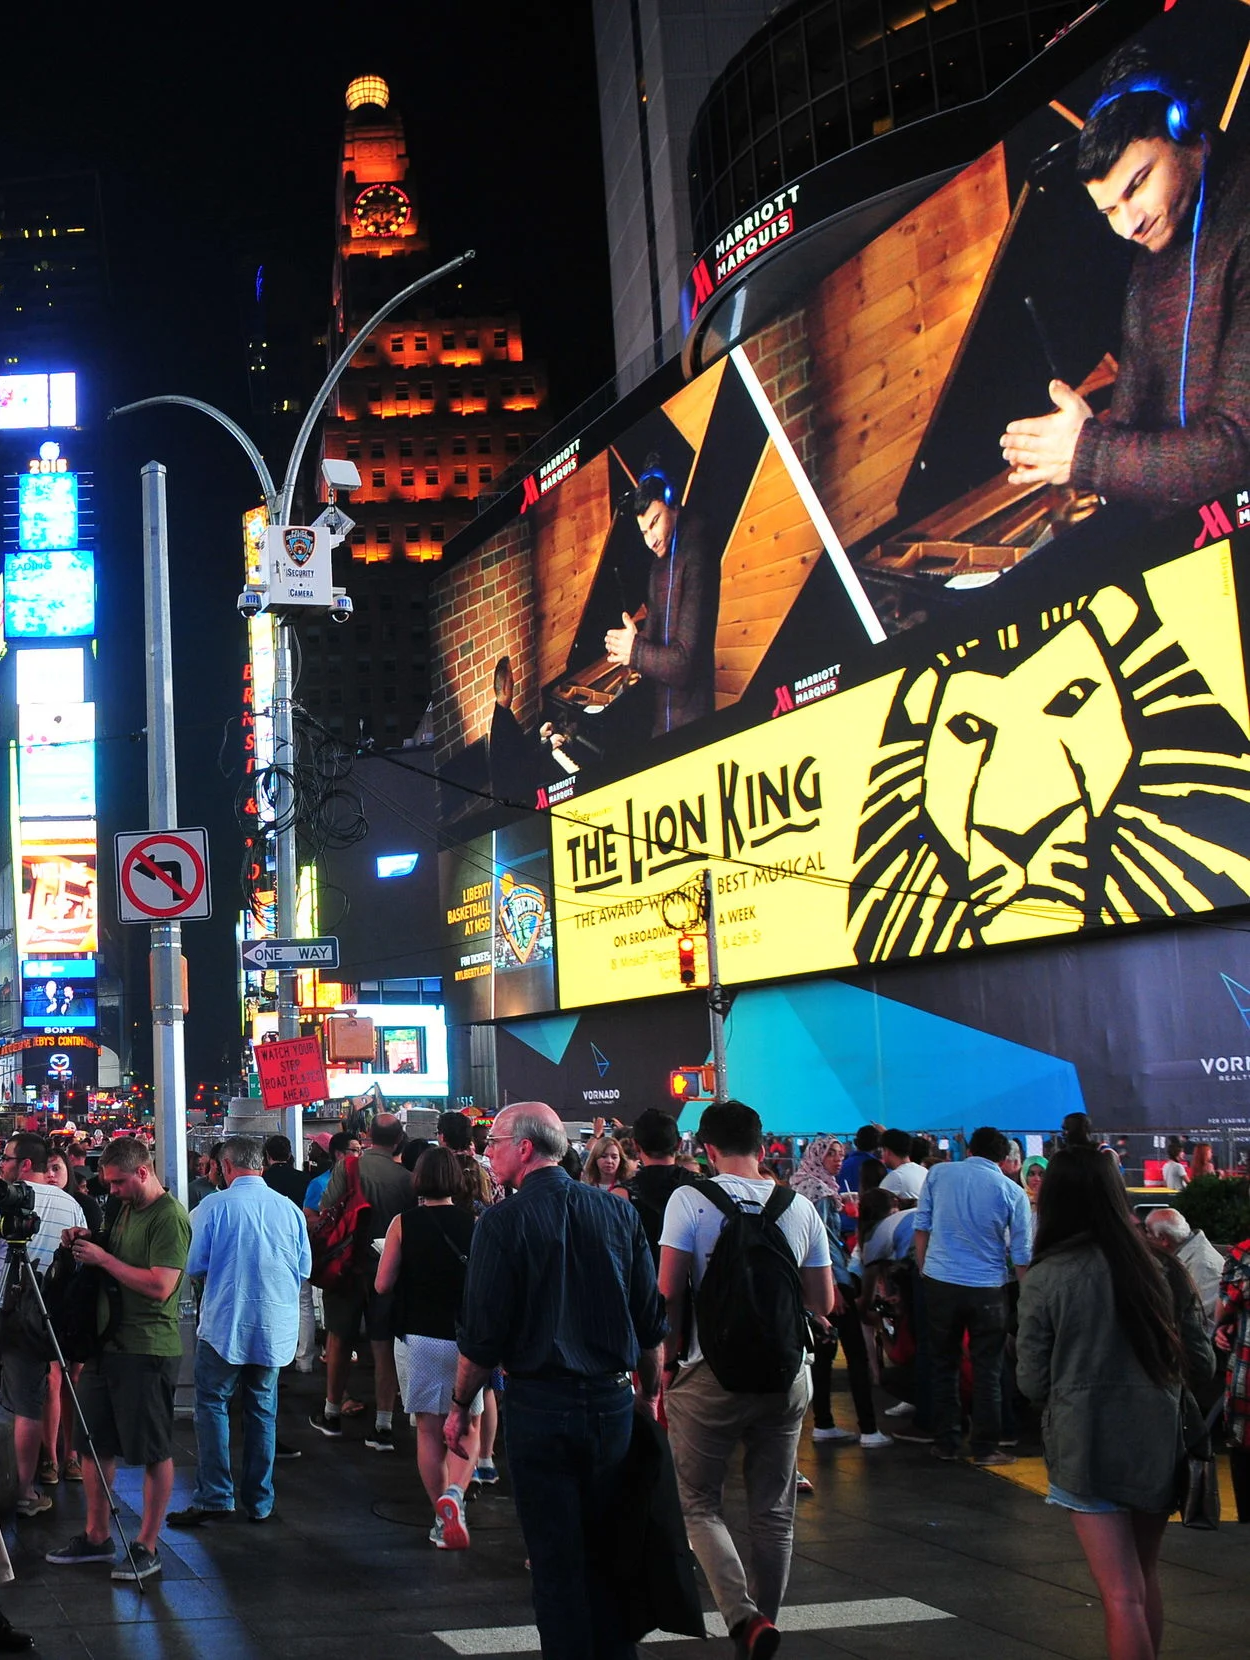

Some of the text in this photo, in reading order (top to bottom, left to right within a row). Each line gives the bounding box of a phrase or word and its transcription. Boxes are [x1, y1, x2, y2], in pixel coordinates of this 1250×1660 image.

[715, 185, 799, 259] MARRIOTT
[717, 215, 789, 280] MARQUIS
[540, 438, 580, 479] MARRIOTT
[541, 458, 577, 493] MARQUIS
[287, 568, 314, 577] SECURITY
[289, 589, 314, 598] CAMERA
[794, 664, 841, 692] MARRIOTT
[795, 680, 836, 704] MARQUIS
[548, 776, 576, 794] MARRIOTT
[567, 756, 822, 885] THE LION KING
[463, 882, 492, 904] LIBERTY
[574, 913, 595, 929] THE
[717, 872, 747, 895] BEST
[754, 852, 825, 887] MUSICAL
[447, 900, 491, 925] BASKETBALL
[465, 916, 491, 936] AT MSG
[614, 936, 627, 948] ON
[718, 912, 726, 926] A
[728, 906, 756, 923] WEEK
[254, 947, 328, 961] ONE WAY
[261, 1042, 314, 1060] WATCH YOUR
[280, 1059, 300, 1072] STEP
[264, 1077, 287, 1089] ROAD
[283, 1087, 310, 1101] AHEAD
[583, 1089, 620, 1100] VORNADO
